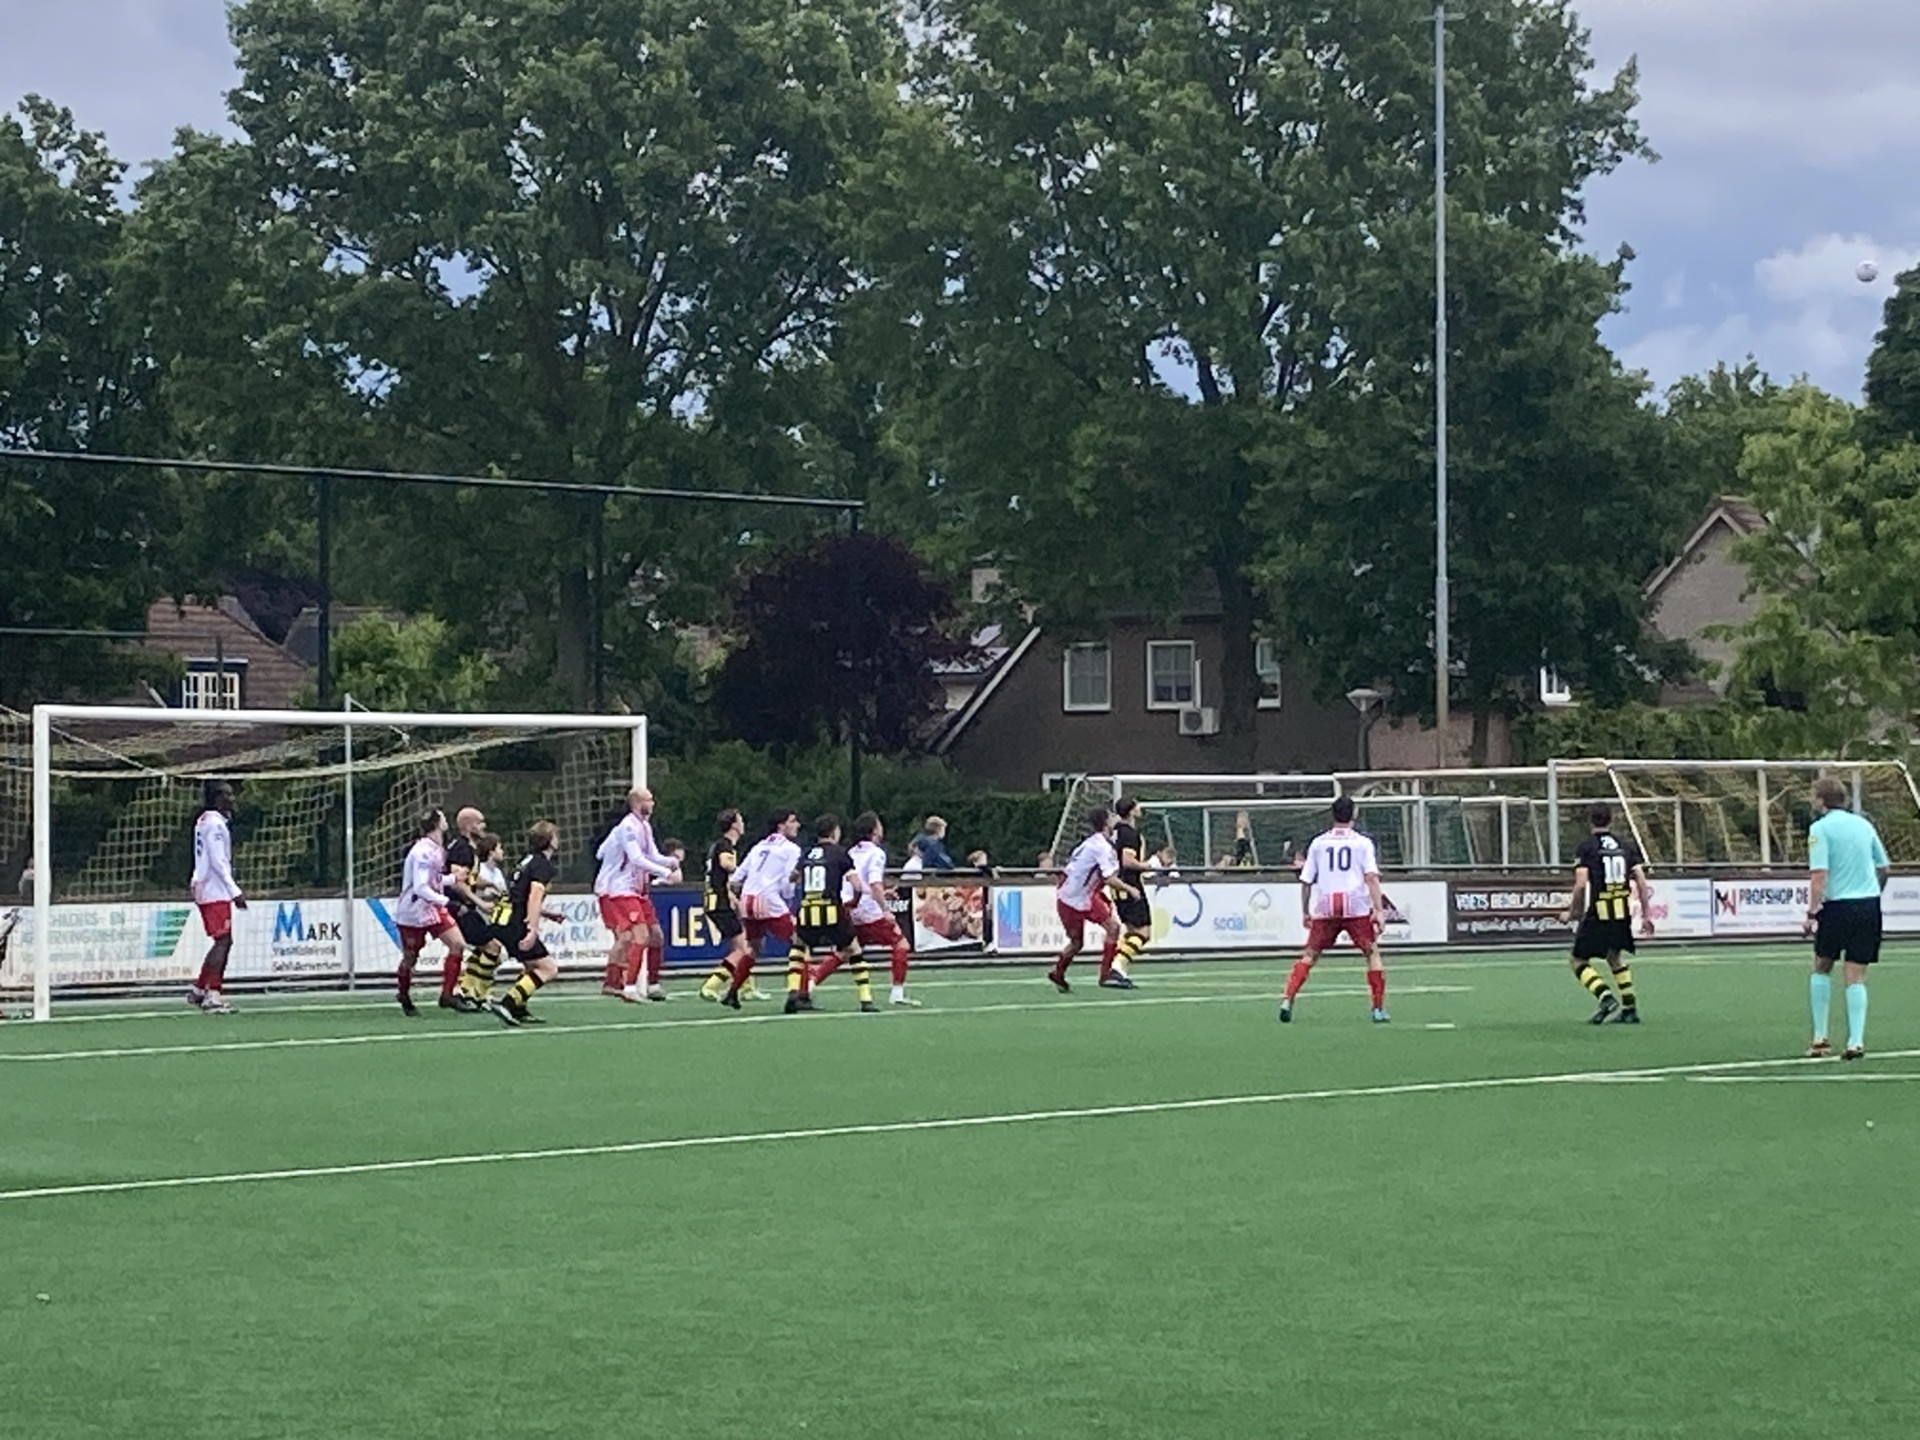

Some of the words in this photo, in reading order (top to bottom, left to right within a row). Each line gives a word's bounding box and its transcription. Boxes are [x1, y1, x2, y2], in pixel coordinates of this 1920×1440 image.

[758, 849, 770, 872] 7
[1325, 846, 1352, 872] 10
[1602, 855, 1626, 884] 10
[804, 865, 826, 892] 18
[272, 901, 343, 943] MARK
